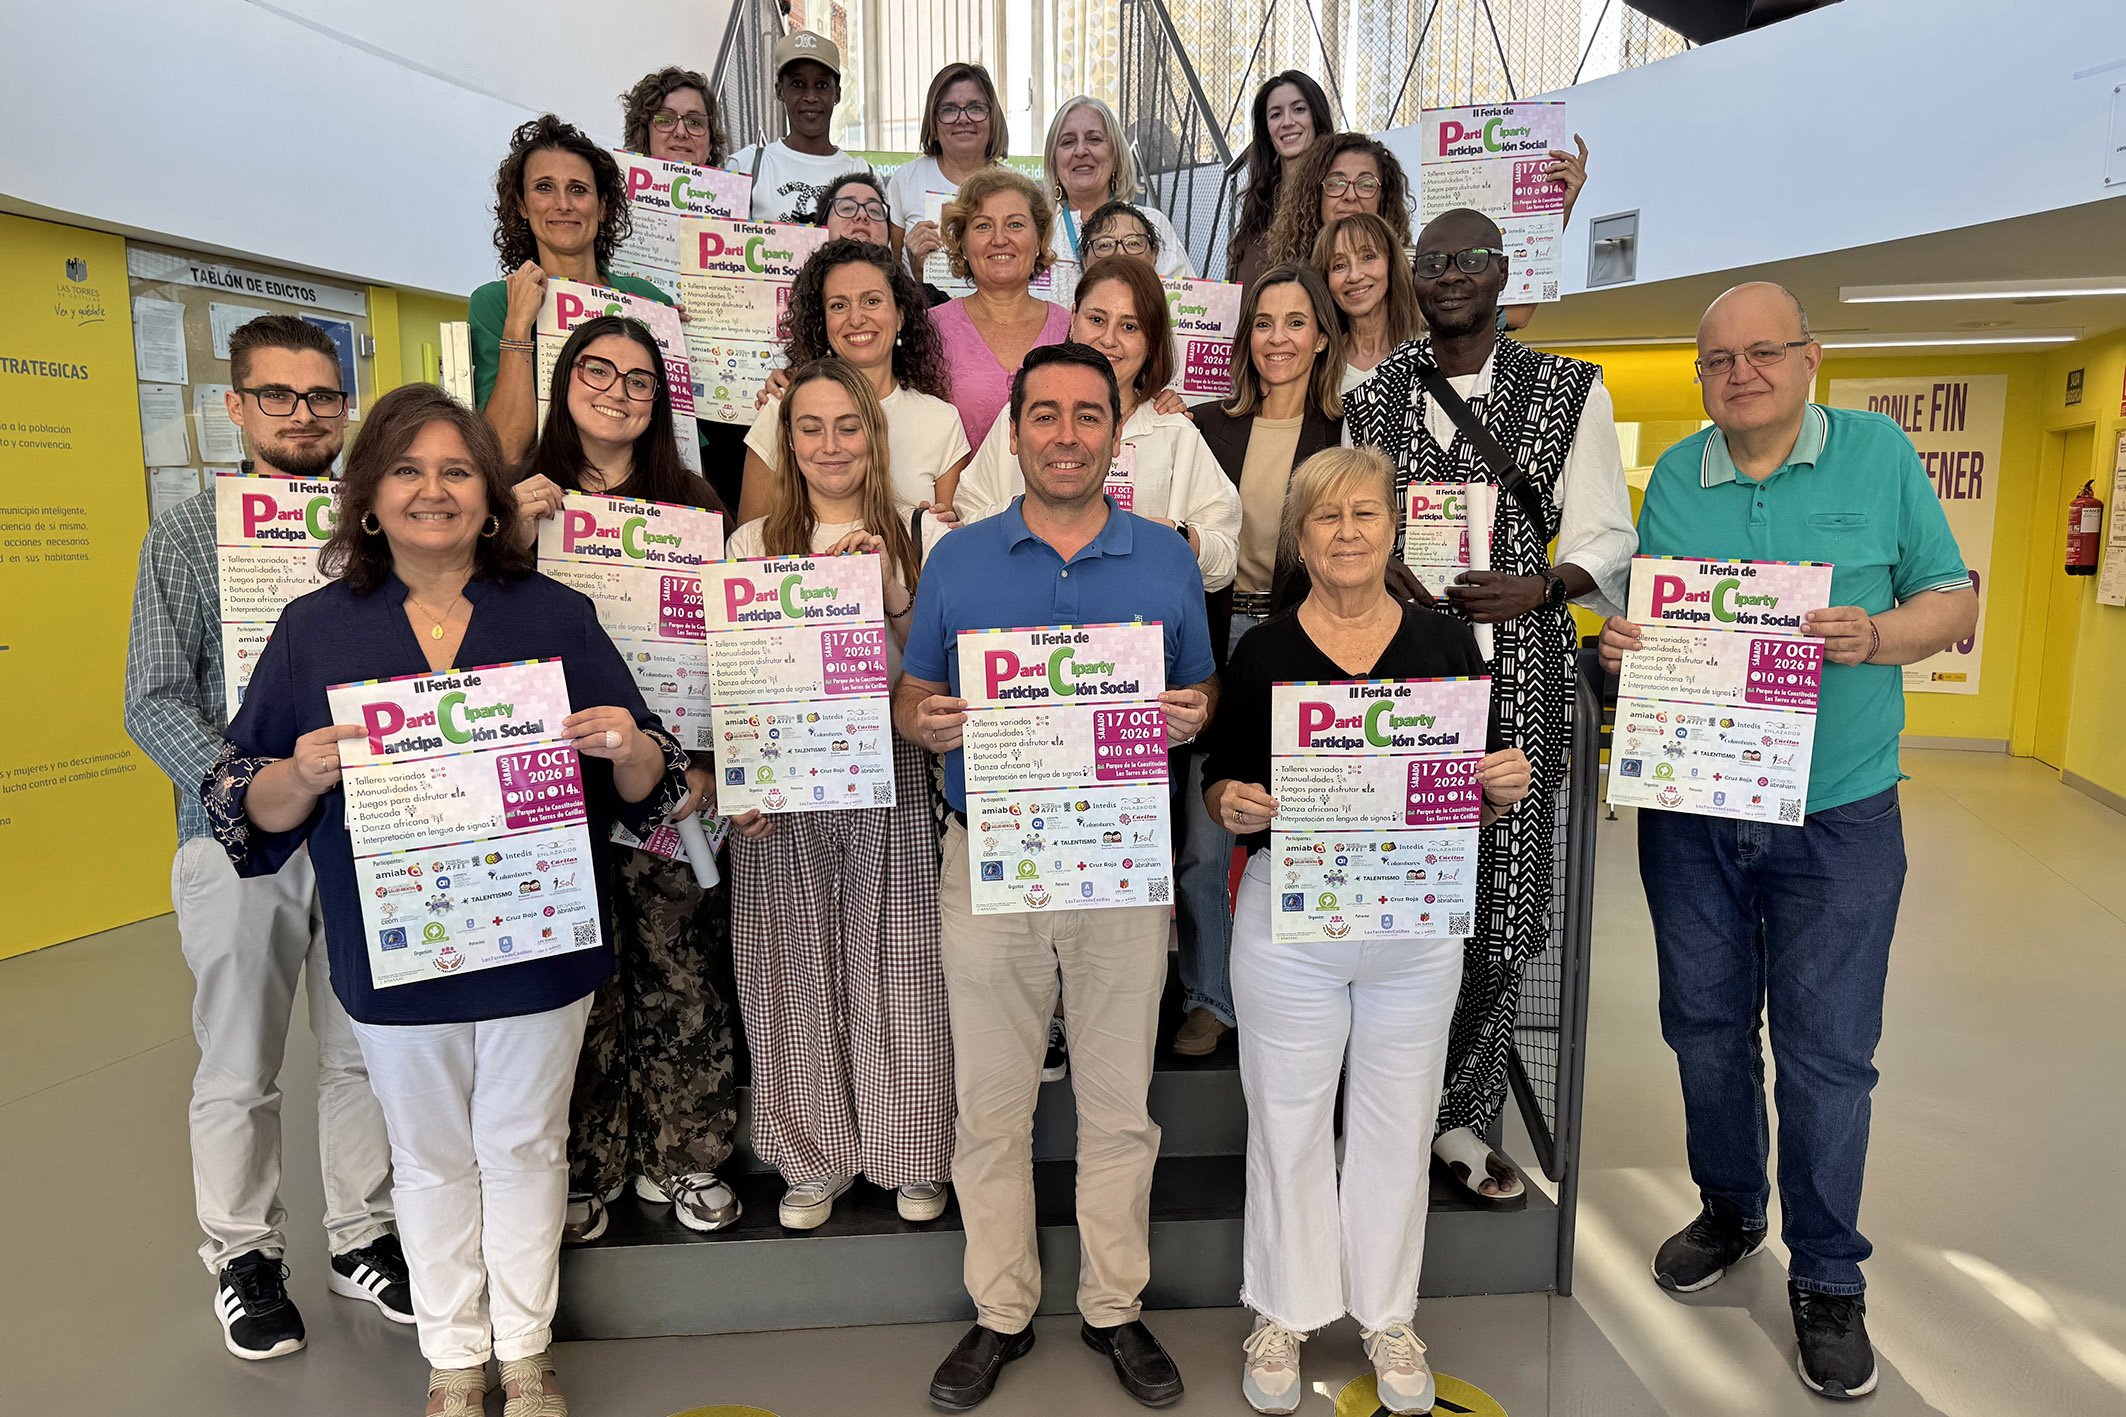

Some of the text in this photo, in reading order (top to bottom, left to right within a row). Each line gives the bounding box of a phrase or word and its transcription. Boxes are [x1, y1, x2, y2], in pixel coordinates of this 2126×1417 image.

[1472, 106, 1514, 117] II Feria de
[1519, 139, 1547, 151] Social
[662, 162, 703, 177] II Feria de
[1522, 163, 1536, 174] 17
[733, 223, 776, 236] II Feria de
[57, 284, 100, 297] LAS TORRES
[190, 267, 317, 302] TABLÓN DE EDICTOS
[591, 288, 632, 305] II Feria de
[54, 302, 68, 316] Ven
[1196, 343, 1209, 354] 17
[1203, 355, 1224, 365] 2026
[1929, 383, 1968, 432] FIN
[18, 423, 26, 431] la
[29, 424, 71, 434] población
[19, 440, 72, 450] convivencia.
[0, 506, 87, 517] municipio inteligente,
[608, 501, 661, 517] II Feria de
[35, 522, 45, 531] de
[60, 523, 88, 531] mismo,
[4, 538, 90, 547] acciones necesarias
[9, 553, 91, 563] en sus habitantes.
[764, 560, 815, 573] II Feria de
[1699, 564, 1757, 577] II Feria de
[1760, 613, 1801, 628] Social
[832, 630, 883, 646] 17 OCT.
[1030, 631, 1089, 645] II Feria de
[844, 646, 871, 657] 2026
[1763, 642, 1821, 659] 17 OCT.
[1774, 658, 1805, 670] 2026
[413, 673, 482, 694] II Feria de
[1099, 679, 1139, 694] Social
[1761, 672, 1818, 687] 10 14h.
[1349, 685, 1412, 698] II Feria de
[1106, 710, 1163, 727] 17 OCT.
[499, 719, 545, 739] Social
[1095, 712, 1105, 740] SÁBADO
[1119, 727, 1150, 739] 2026
[1417, 732, 1459, 747] Social
[1109, 742, 1165, 756] 10 a 14h.
[6, 749, 131, 779] y mujeres y no descriminación
[511, 748, 576, 772] 17 OCT.
[498, 757, 513, 787] SÁBADO
[528, 767, 563, 784] 2026
[1421, 763, 1442, 776] 17
[2, 763, 137, 794] lucha contra el cambio climático
[354, 770, 426, 787] Talleres variados
[1434, 776, 1466, 788] 2026
[355, 782, 418, 798] Manualidades
[518, 782, 581, 803] 10 a 14h.
[1421, 792, 1435, 803] 10
[1459, 790, 1480, 801] 14h.
[357, 790, 448, 812] Juegos para disfrutar
[516, 807, 536, 817] Parque
[551, 799, 584, 811] Constitución
[1092, 801, 1116, 809] Intedis
[359, 808, 401, 821] Batucada
[528, 815, 538, 823] Las
[539, 812, 556, 821] Torres
[564, 807, 585, 817] Cotillas
[981, 806, 1008, 814] amiab
[361, 815, 429, 833] Danza africana
[363, 830, 416, 846] Interpretación
[427, 825, 454, 838] lengua
[454, 823, 465, 832] de
[466, 820, 490, 832] signos
[505, 849, 533, 861] Intedis
[375, 868, 407, 880] amiab
[471, 890, 513, 903] TALENTISMO
[557, 903, 585, 915] abraham
[505, 911, 538, 922] Cruz Roja
